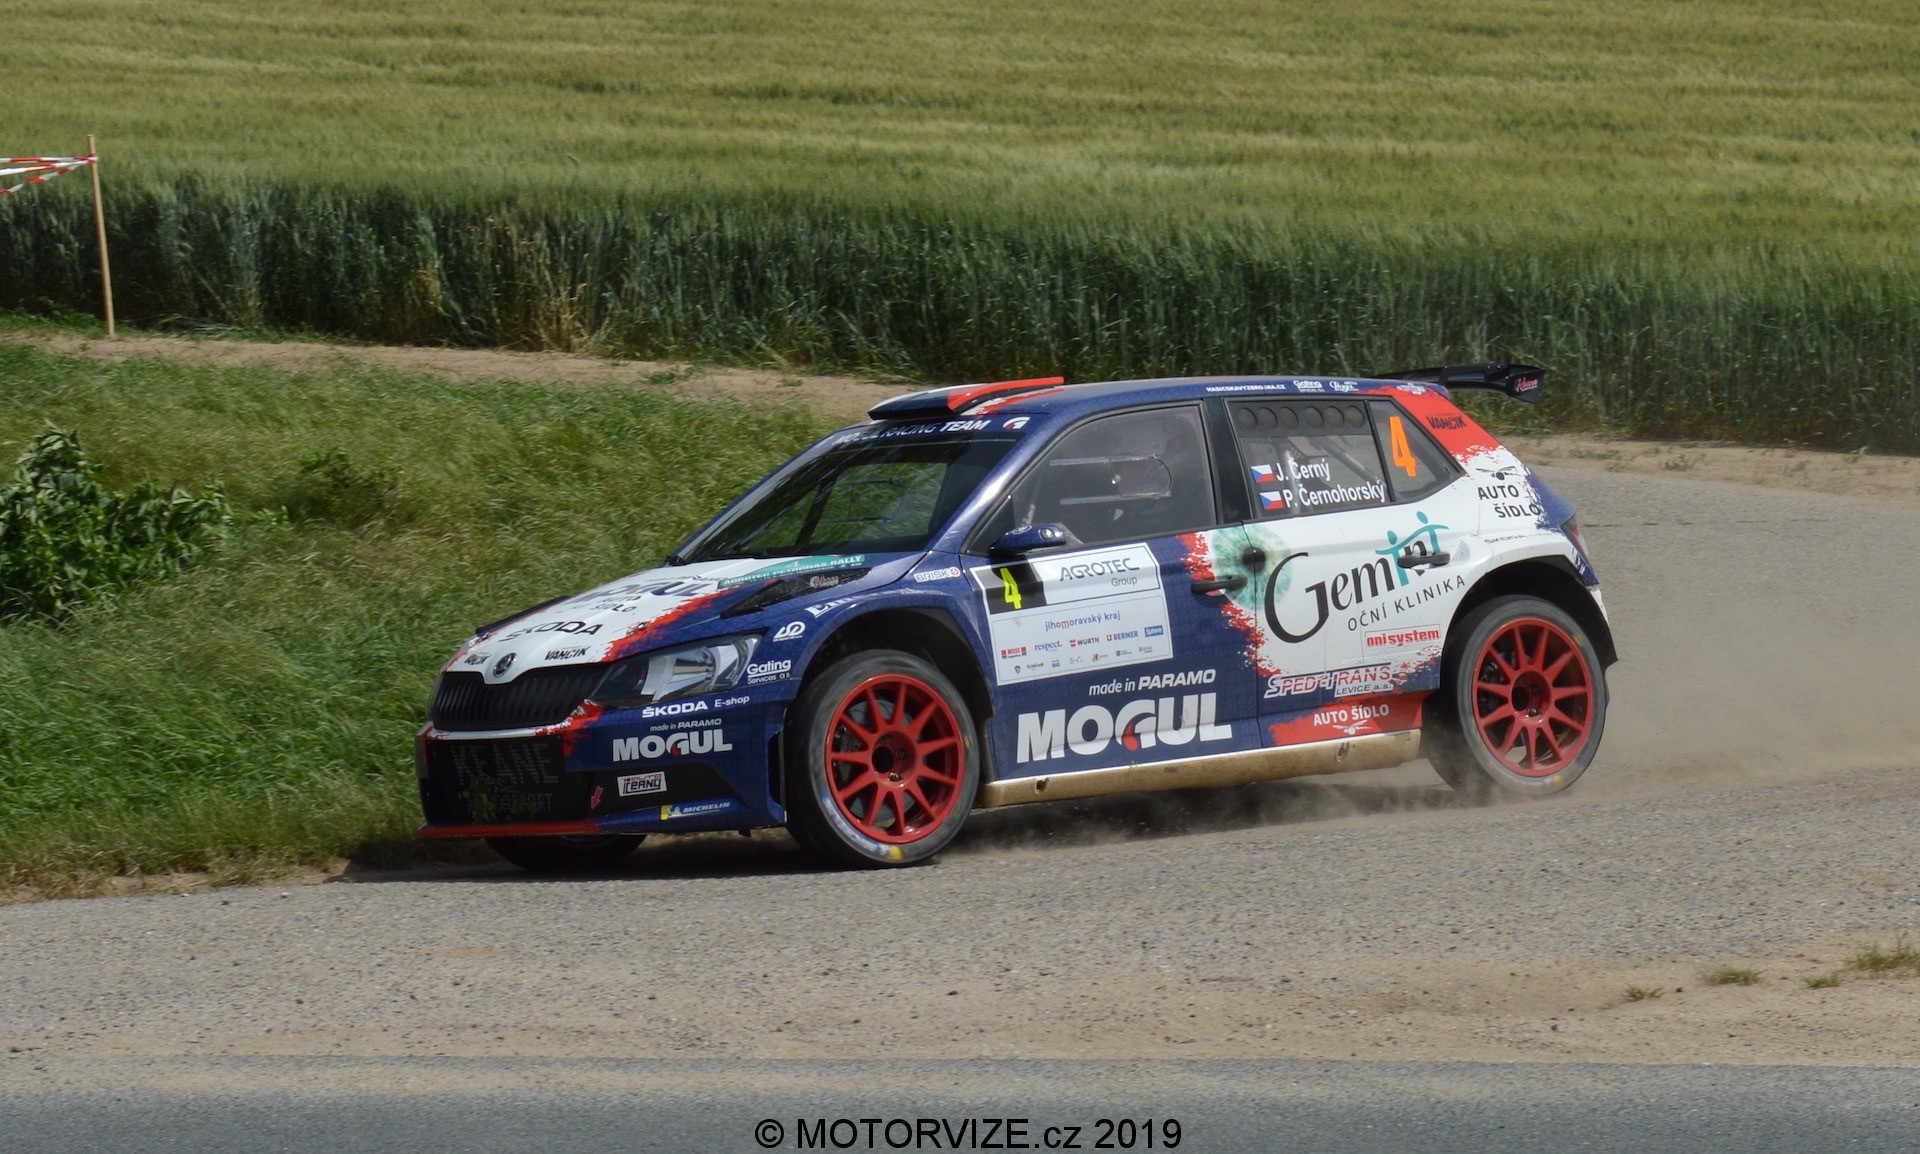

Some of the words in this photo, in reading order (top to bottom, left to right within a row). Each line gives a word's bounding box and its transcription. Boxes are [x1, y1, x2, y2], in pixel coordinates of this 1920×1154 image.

[939, 419, 992, 433] TEAM
[1389, 416, 1418, 478] 4
[1276, 462, 1289, 482] J.
[1289, 457, 1331, 482] Černý
[1283, 489, 1298, 509] P.
[1298, 479, 1386, 507] Černohorský
[1477, 484, 1520, 500] AUTO
[1493, 502, 1542, 519] ŠÍDLO
[829, 554, 863, 566] RALLY
[1059, 557, 1140, 582] AGROTEC
[916, 570, 949, 582] BRISK
[1111, 575, 1138, 587] Group
[1000, 567, 1023, 610] 4
[1347, 604, 1388, 632] OČNÍ
[1394, 574, 1466, 614] KLINIKA
[1045, 613, 1102, 632] jihomoravský
[1104, 610, 1121, 625] kraj
[1113, 630, 1139, 641] BERNER
[747, 660, 791, 678] Gating
[1088, 679, 1122, 696] made
[1124, 677, 1136, 692] in
[1137, 669, 1217, 691] PARAMO
[1336, 684, 1371, 696] LEVICE
[1373, 684, 1392, 692] a.s.
[641, 700, 709, 719] ŠKODA
[714, 696, 750, 708] E-shop
[1314, 710, 1348, 726] AUTO
[1351, 704, 1390, 721] ŠÍDLO
[650, 724, 669, 732] made
[670, 722, 677, 730] in
[677, 718, 722, 729] PARAMO
[1016, 692, 1233, 764] MOGUL
[612, 729, 733, 763] MOGUL
[683, 802, 731, 814] MICHELIN
